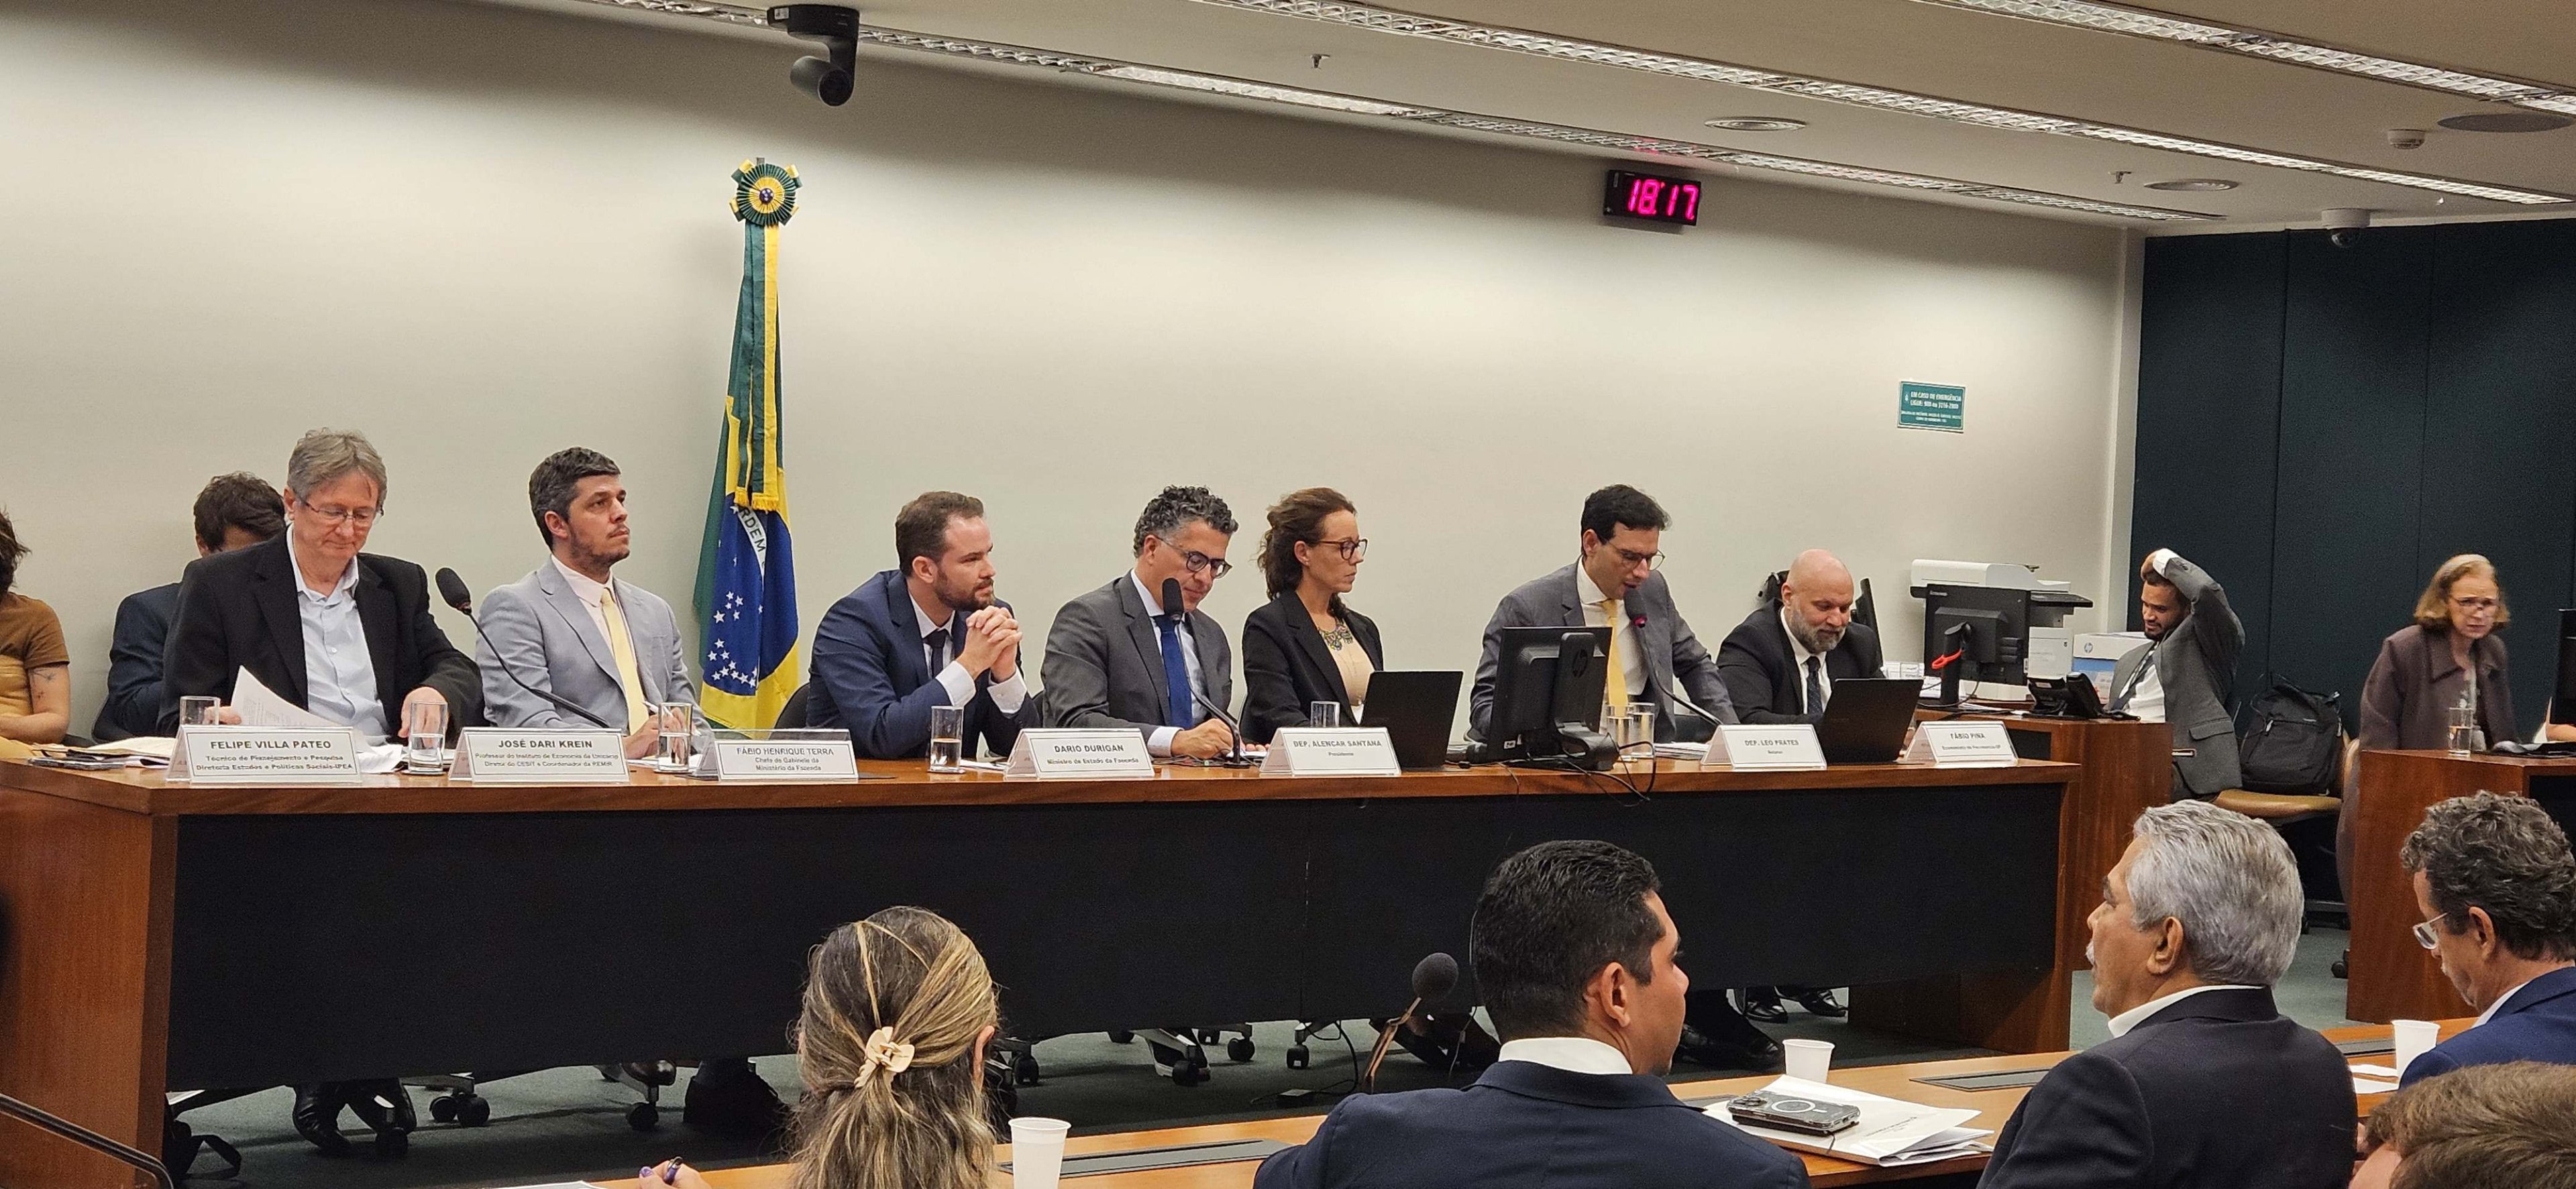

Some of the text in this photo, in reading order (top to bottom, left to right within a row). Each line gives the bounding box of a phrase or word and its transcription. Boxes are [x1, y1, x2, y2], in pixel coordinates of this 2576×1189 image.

[210, 740, 331, 749] FELIPE VILLA PATEO
[498, 738, 592, 748] JOSÉ DARI KREIN
[737, 746, 835, 756] FÁBIO HENRIQUE TERRA
[1054, 744, 1124, 752] DARIO DURIGAN
